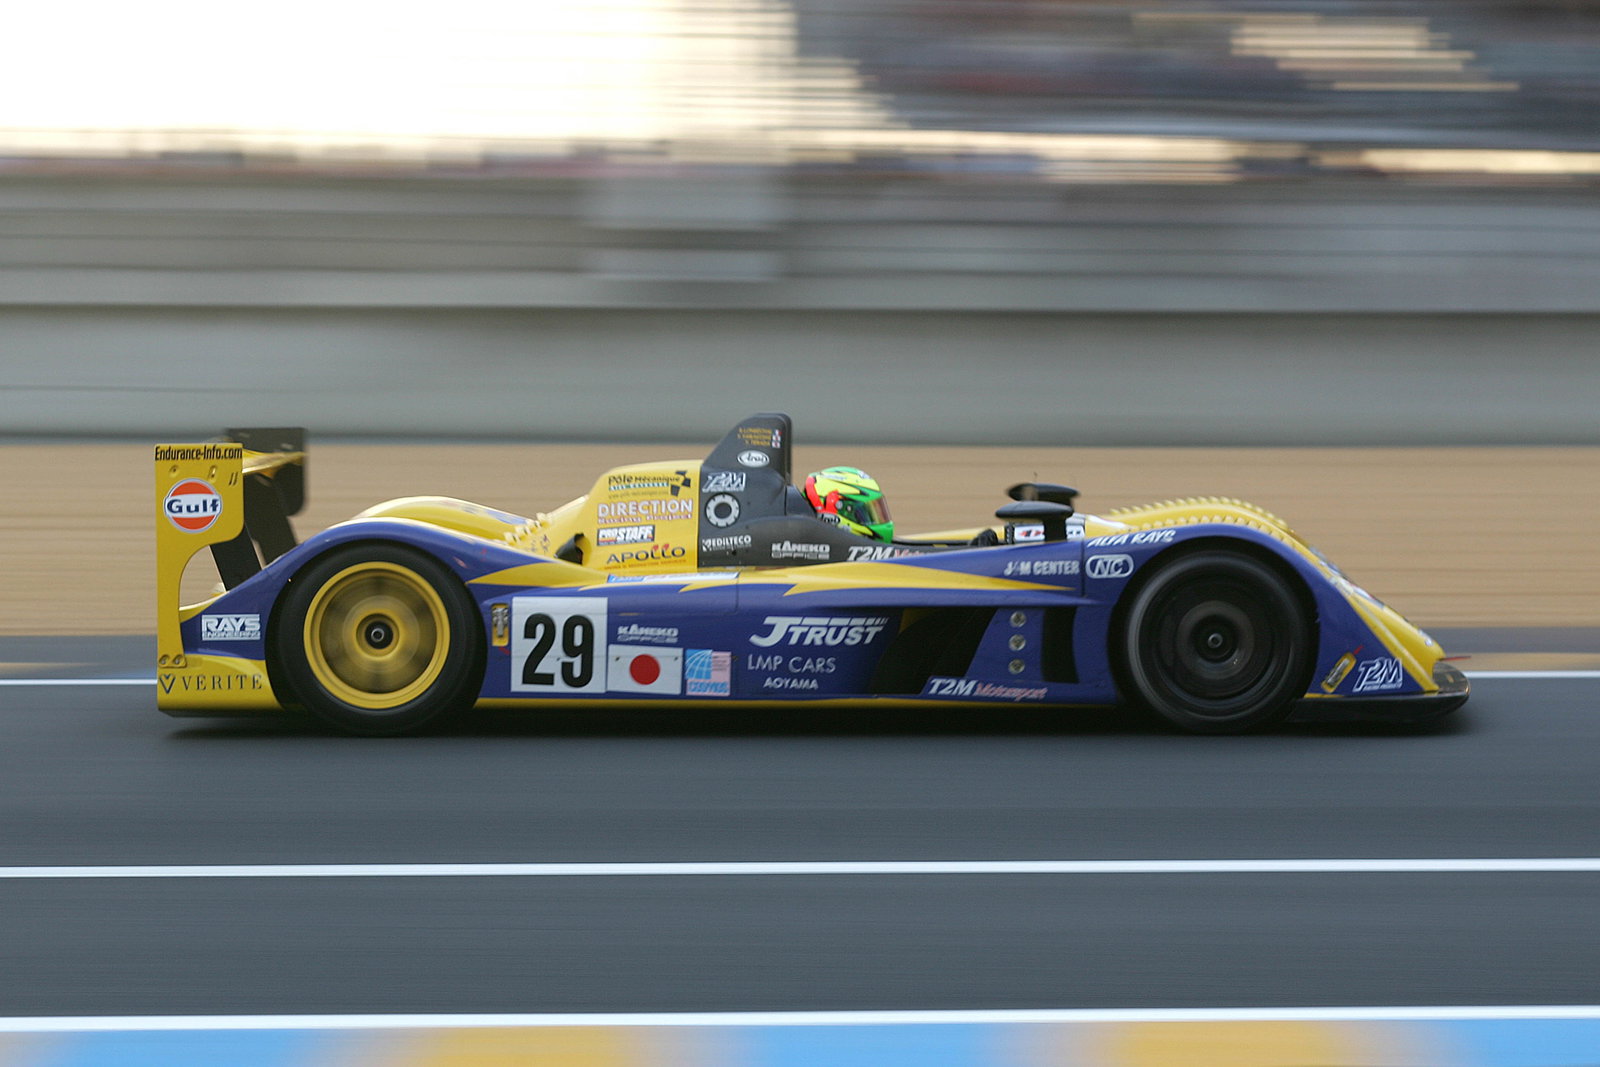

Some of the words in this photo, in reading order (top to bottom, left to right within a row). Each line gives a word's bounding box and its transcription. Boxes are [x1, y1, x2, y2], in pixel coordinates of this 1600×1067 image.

[155, 445, 243, 461] Endurance-Info.com
[167, 499, 220, 514] Gulf
[598, 499, 693, 518] DIRECTION
[1130, 529, 1176, 544] RAYS
[847, 546, 894, 561] T2M
[1032, 560, 1080, 575] CENTER
[202, 616, 260, 632] RAYS
[522, 613, 595, 688] 29
[748, 654, 783, 671] LMP
[788, 656, 836, 673] CARS
[182, 673, 263, 691] VERITE
[763, 677, 819, 690] AOYAMA
[928, 678, 977, 696] T2M
